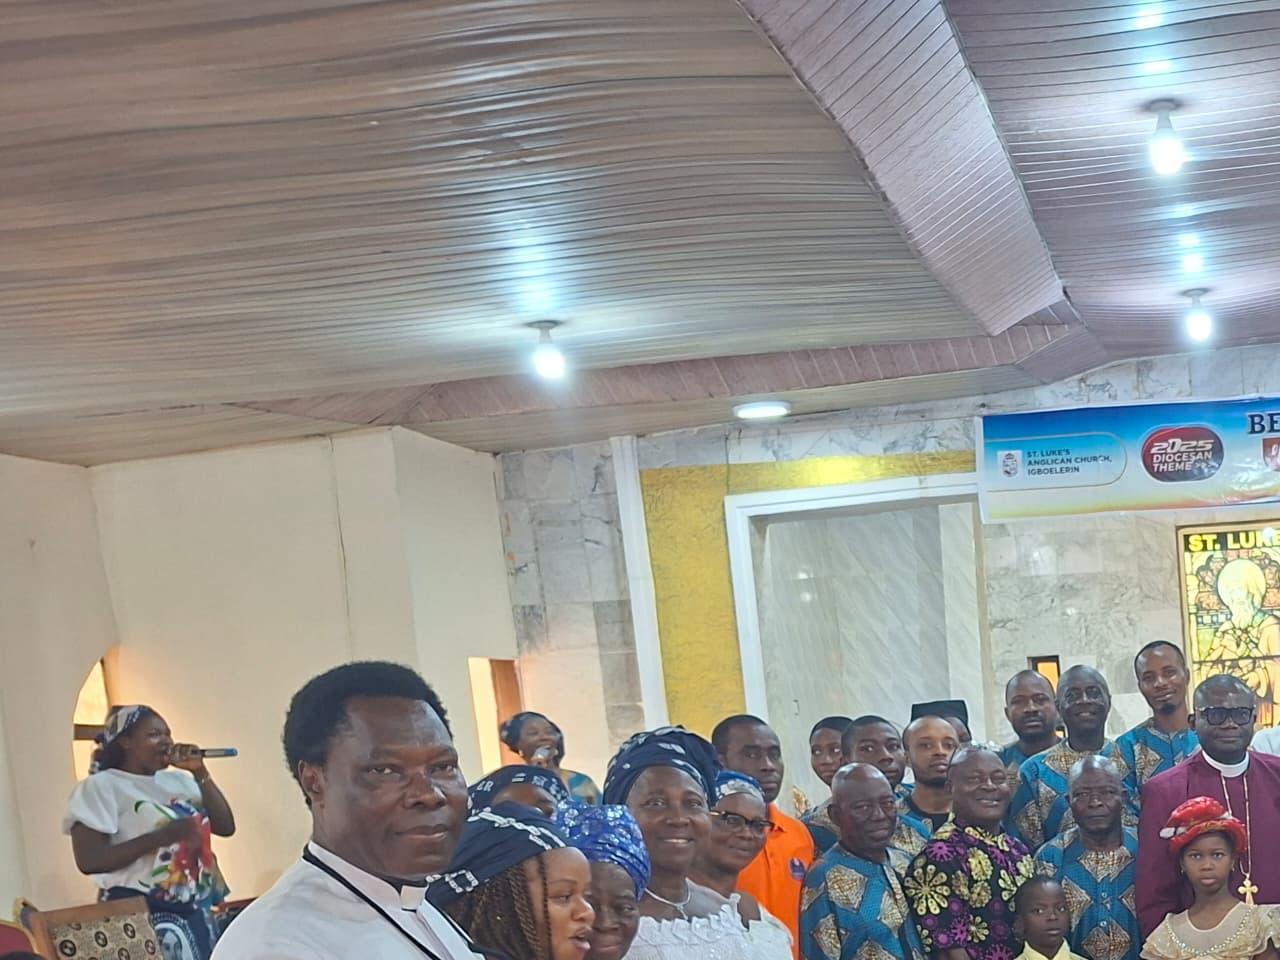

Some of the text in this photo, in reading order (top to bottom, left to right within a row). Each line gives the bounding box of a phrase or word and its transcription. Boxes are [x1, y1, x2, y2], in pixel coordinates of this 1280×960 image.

[1150, 438, 1215, 454] 2025
[1041, 448, 1071, 457] LUKE'S
[1152, 451, 1213, 463] DIOCESAN
[1027, 457, 1073, 467] ANGLICAN
[1152, 461, 1193, 473] THEME
[1188, 533, 1221, 551] ST.
